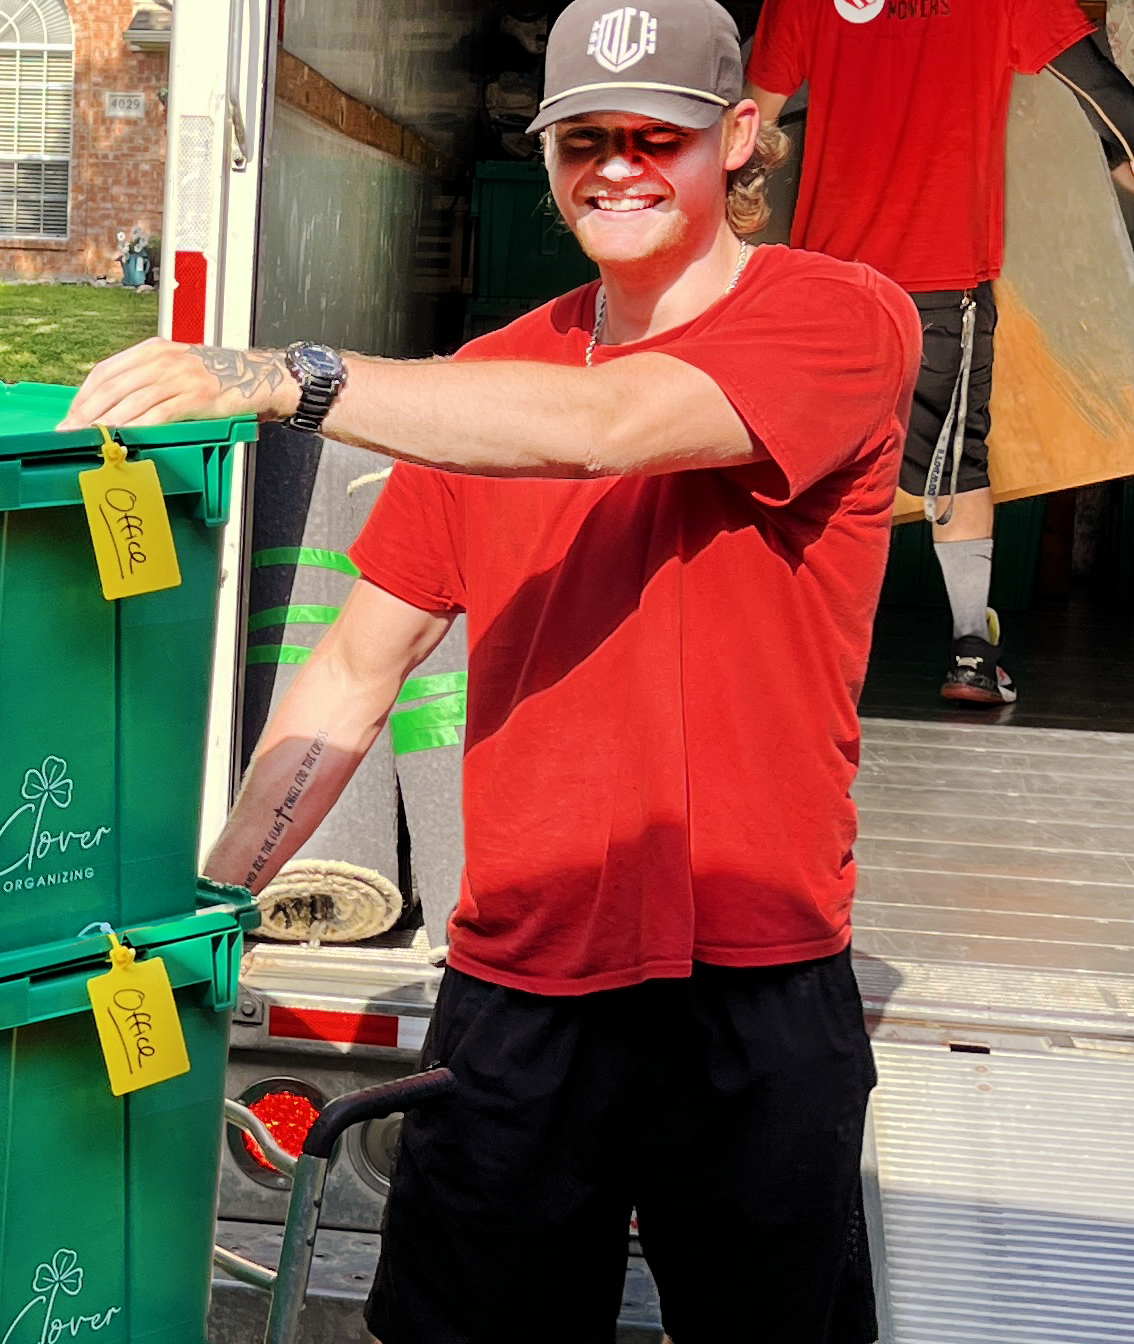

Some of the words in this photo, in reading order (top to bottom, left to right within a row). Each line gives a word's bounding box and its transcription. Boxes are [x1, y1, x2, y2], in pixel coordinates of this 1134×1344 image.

[111, 98, 141, 110] 4029
[104, 487, 147, 575] Office
[269, 821, 285, 843] FLAG
[311, 728, 329, 756] CROSS
[2, 866, 95, 893] ORGANIZING
[113, 988, 156, 1069] Office
